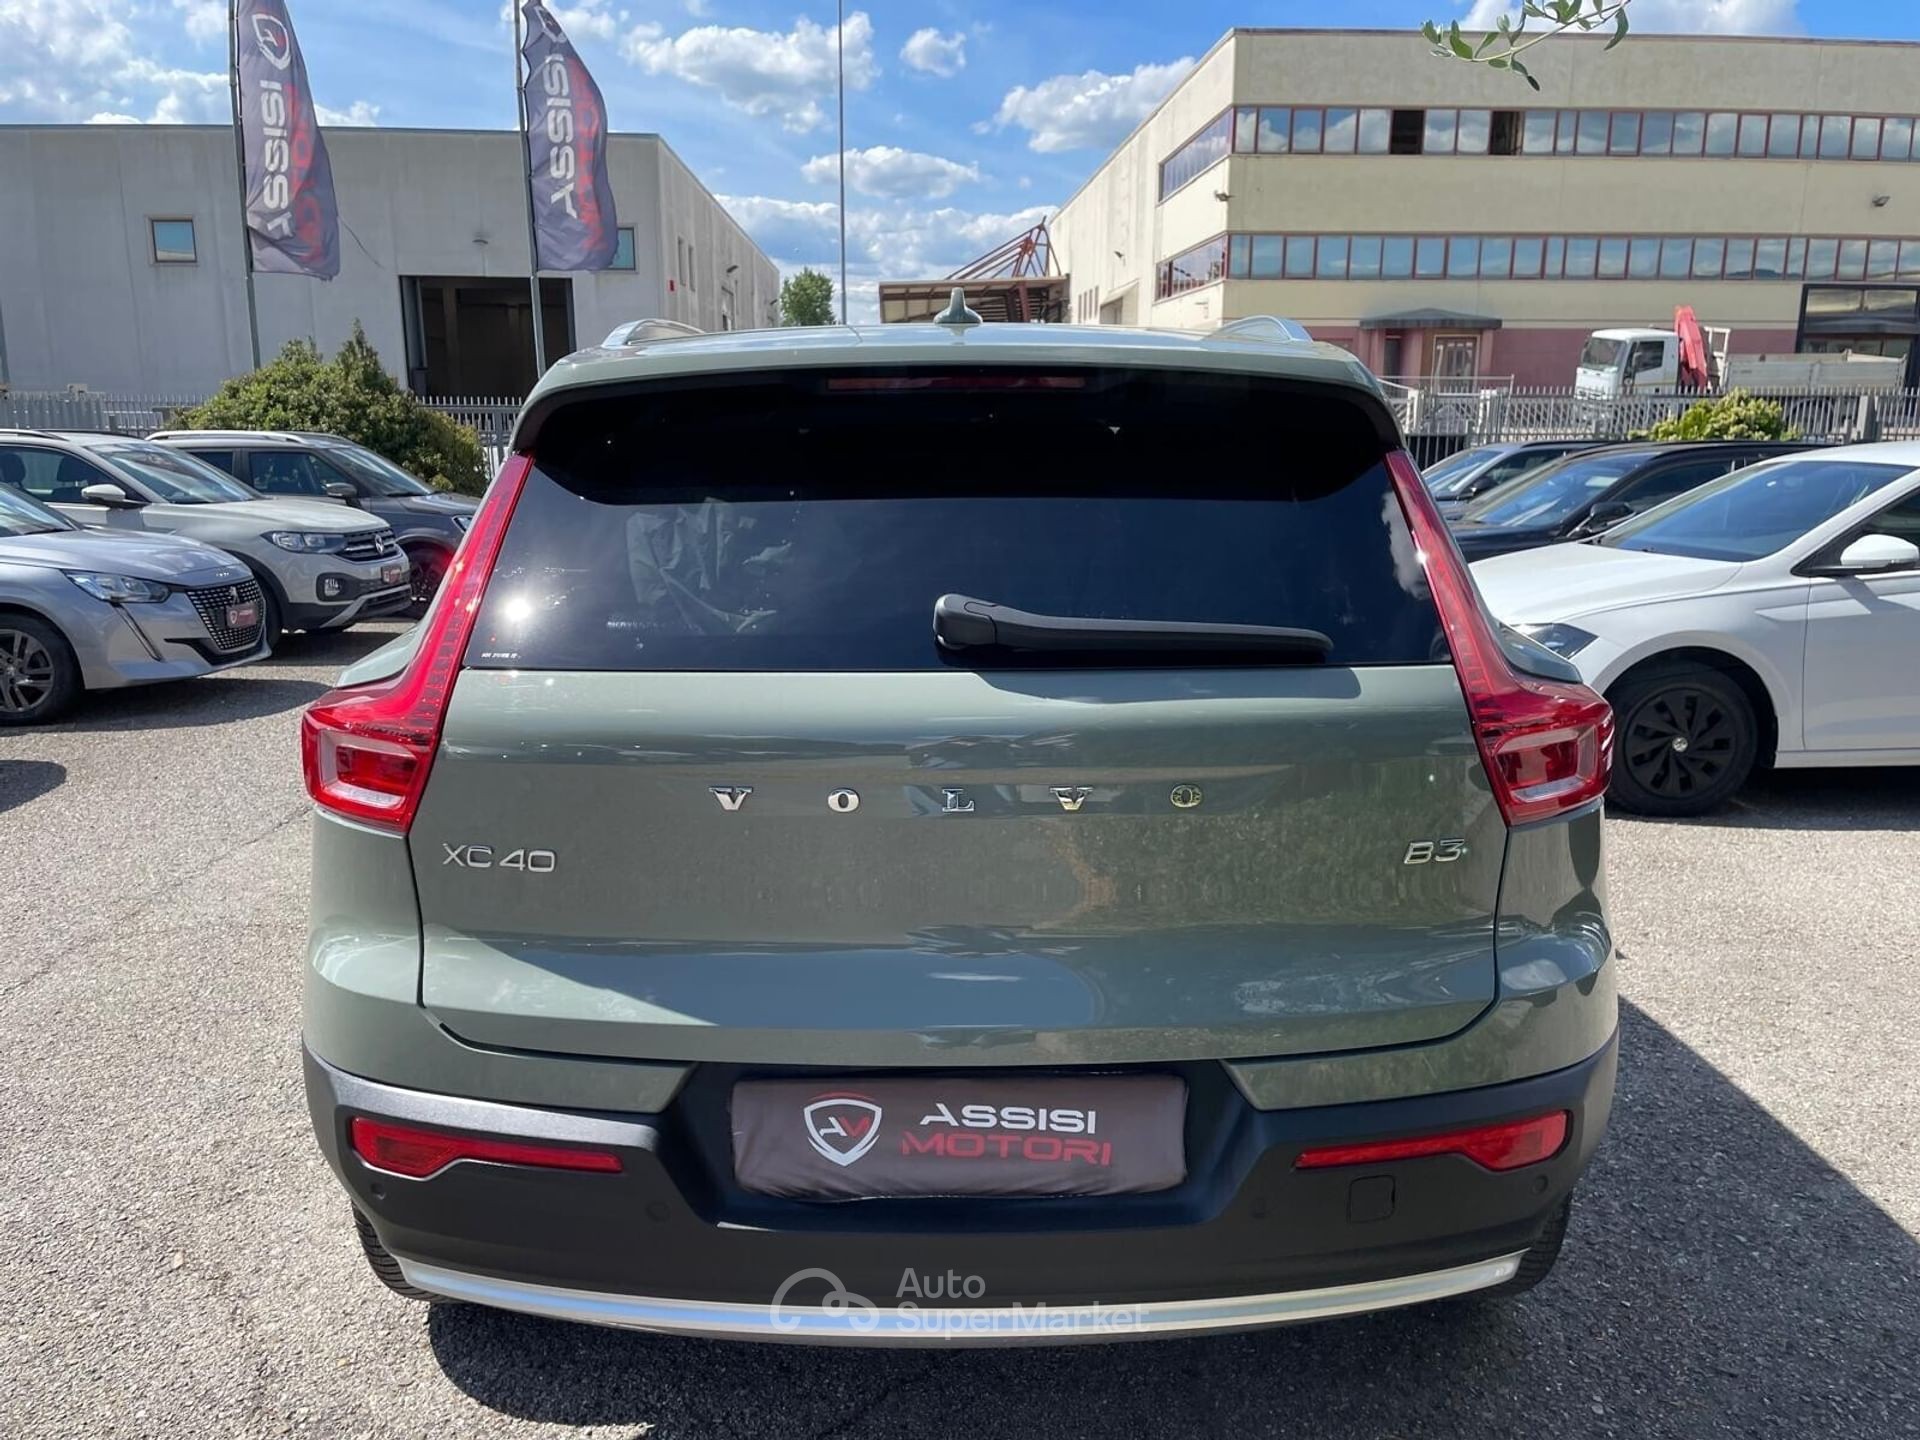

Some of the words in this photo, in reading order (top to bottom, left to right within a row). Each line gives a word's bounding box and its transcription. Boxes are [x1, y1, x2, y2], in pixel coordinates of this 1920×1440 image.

[543, 53, 577, 219] ASSISI
[260, 80, 294, 238] ASSISI
[709, 785, 1202, 813] VOLVO
[1404, 838, 1465, 864] B3
[920, 1103, 1096, 1134] ASSISI
[902, 1132, 1112, 1166] MOTORI
